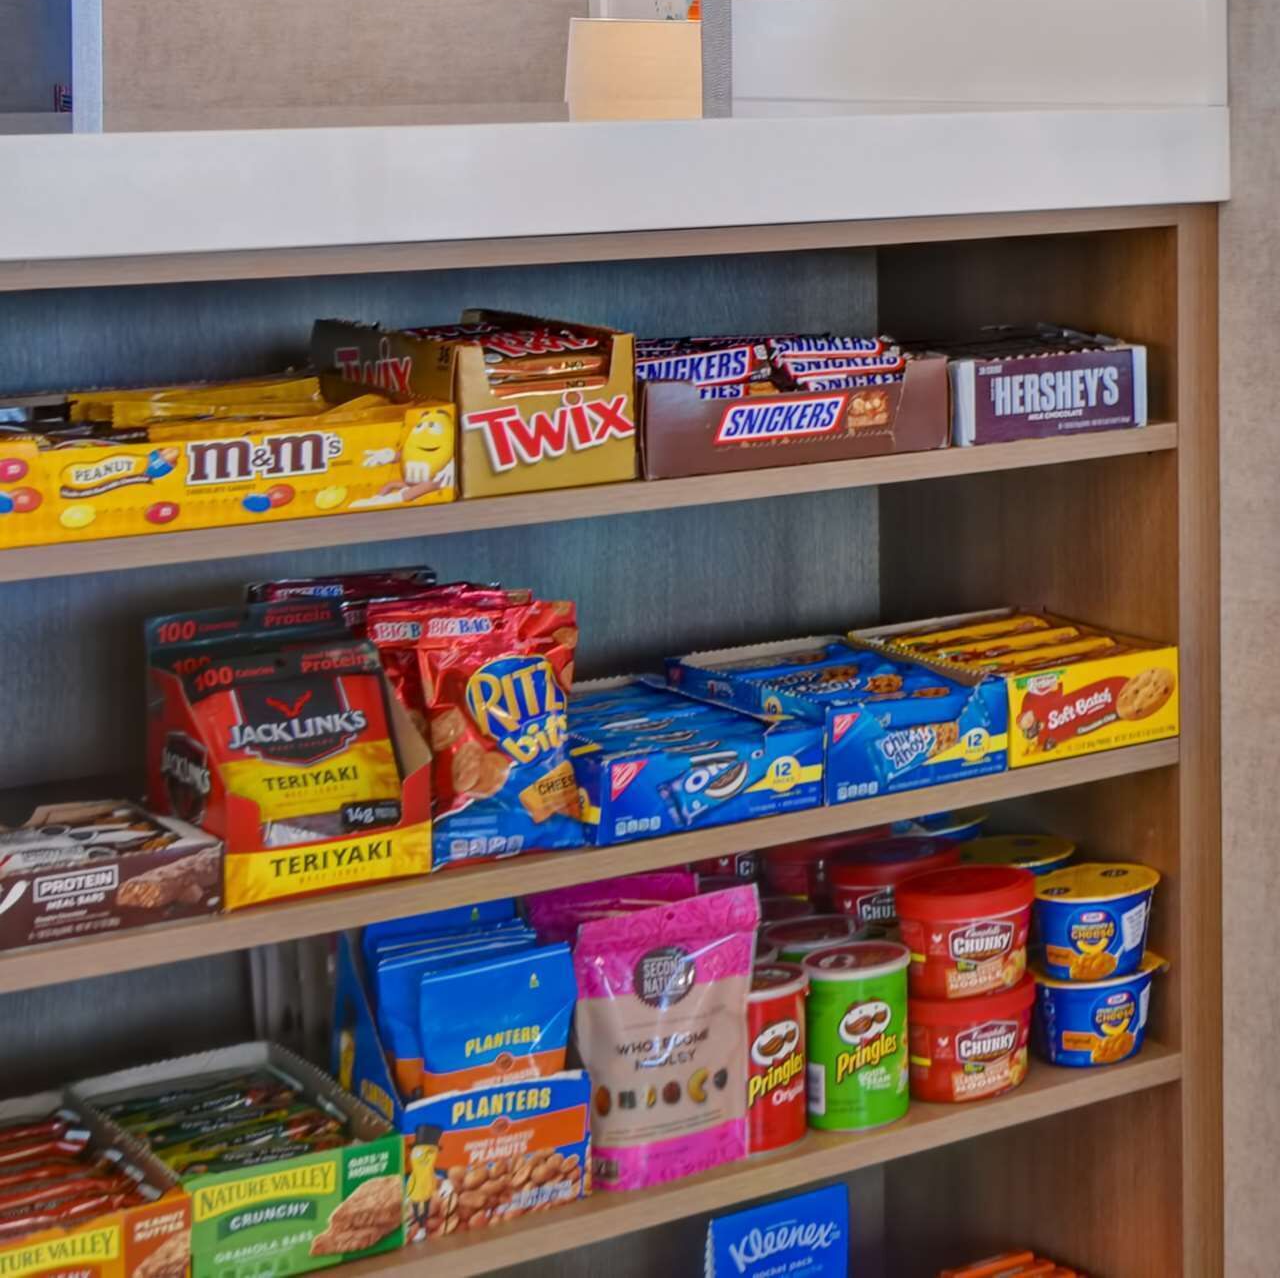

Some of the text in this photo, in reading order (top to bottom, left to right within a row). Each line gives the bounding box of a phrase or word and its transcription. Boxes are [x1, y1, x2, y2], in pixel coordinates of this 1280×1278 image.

[995, 366, 1120, 417] HERSHEY'S
[724, 400, 841, 438] SNICKERS
[74, 460, 134, 482] PEANUT
[158, 621, 196, 643] 100
[429, 619, 456, 636] BIG
[459, 618, 490, 634] BAG
[301, 651, 369, 673] Protein
[195, 665, 234, 690] 100
[467, 661, 564, 735] RITZ
[1048, 687, 1112, 730] Soft Batch
[967, 733, 983, 748] 12
[263, 765, 360, 793] TERIYAKI
[774, 762, 792, 777] 12
[537, 772, 574, 797] CHEES
[271, 839, 394, 878] TERIYAKI
[41, 869, 113, 895] PROTEIN
[46, 892, 106, 912] MEAL BARS
[953, 932, 1012, 956] CHUNKY
[643, 958, 686, 980] SECOND
[464, 1025, 541, 1058] PLANTERS
[960, 1032, 1017, 1058] CHUNKY
[836, 1034, 897, 1084] Pringles
[748, 1052, 805, 1109] Pringles
[452, 1088, 552, 1126] PLANTERS
[469, 1141, 529, 1163] PEANUTS
[199, 1164, 334, 1218] NATURE VALLEY
[229, 1201, 311, 1232] CRUNCHY
[0, 1229, 114, 1274] TURE VALLEY
[728, 1220, 834, 1273] Kleenex
